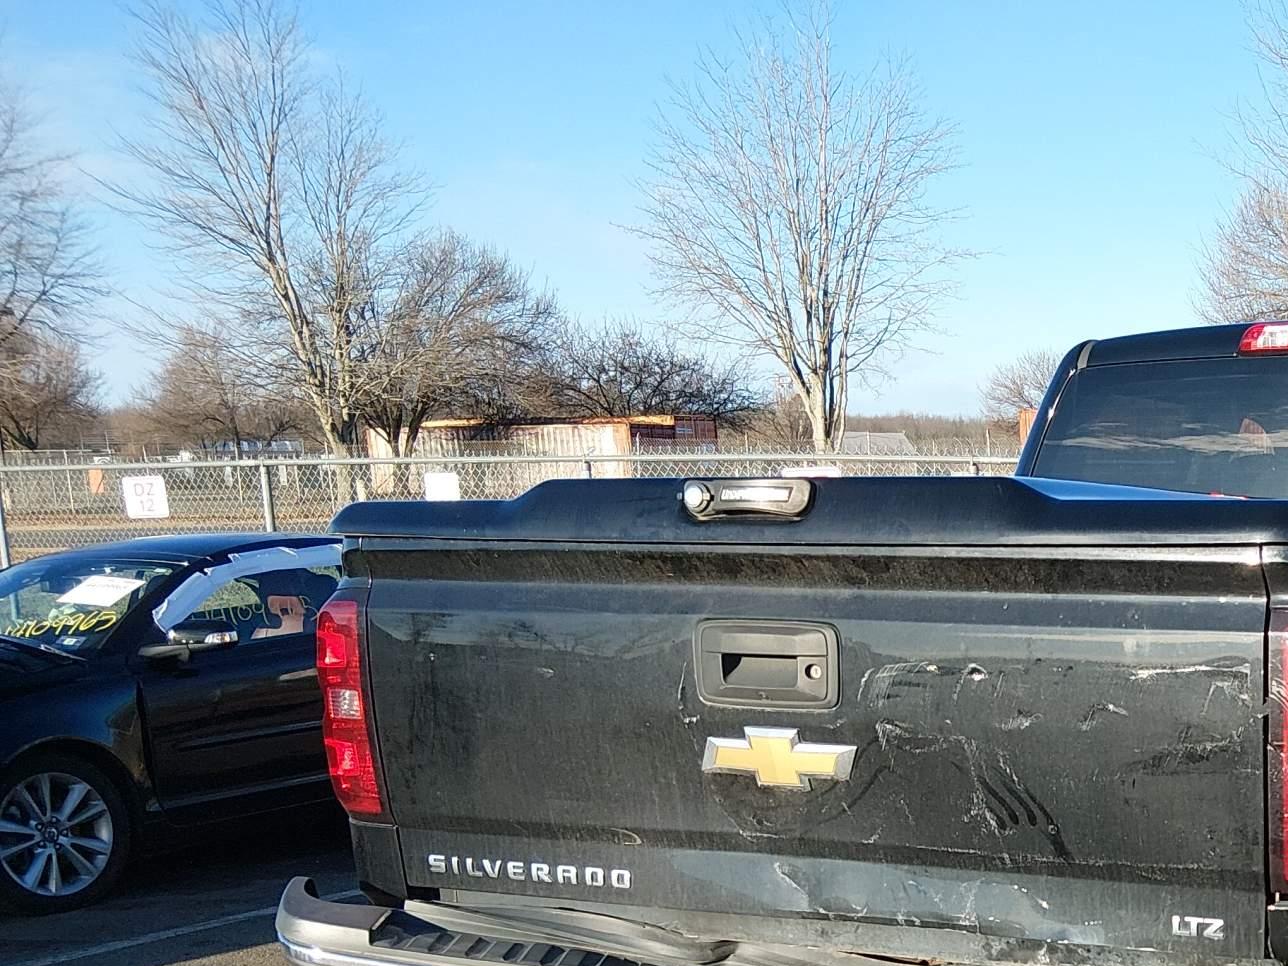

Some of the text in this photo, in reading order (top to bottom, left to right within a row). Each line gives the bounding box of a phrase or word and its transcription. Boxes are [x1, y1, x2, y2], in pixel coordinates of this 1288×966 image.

[133, 482, 156, 497] DZ
[139, 498, 156, 512] 12
[427, 853, 633, 889] SILVERADO
[1171, 914, 1225, 940] LTZ
